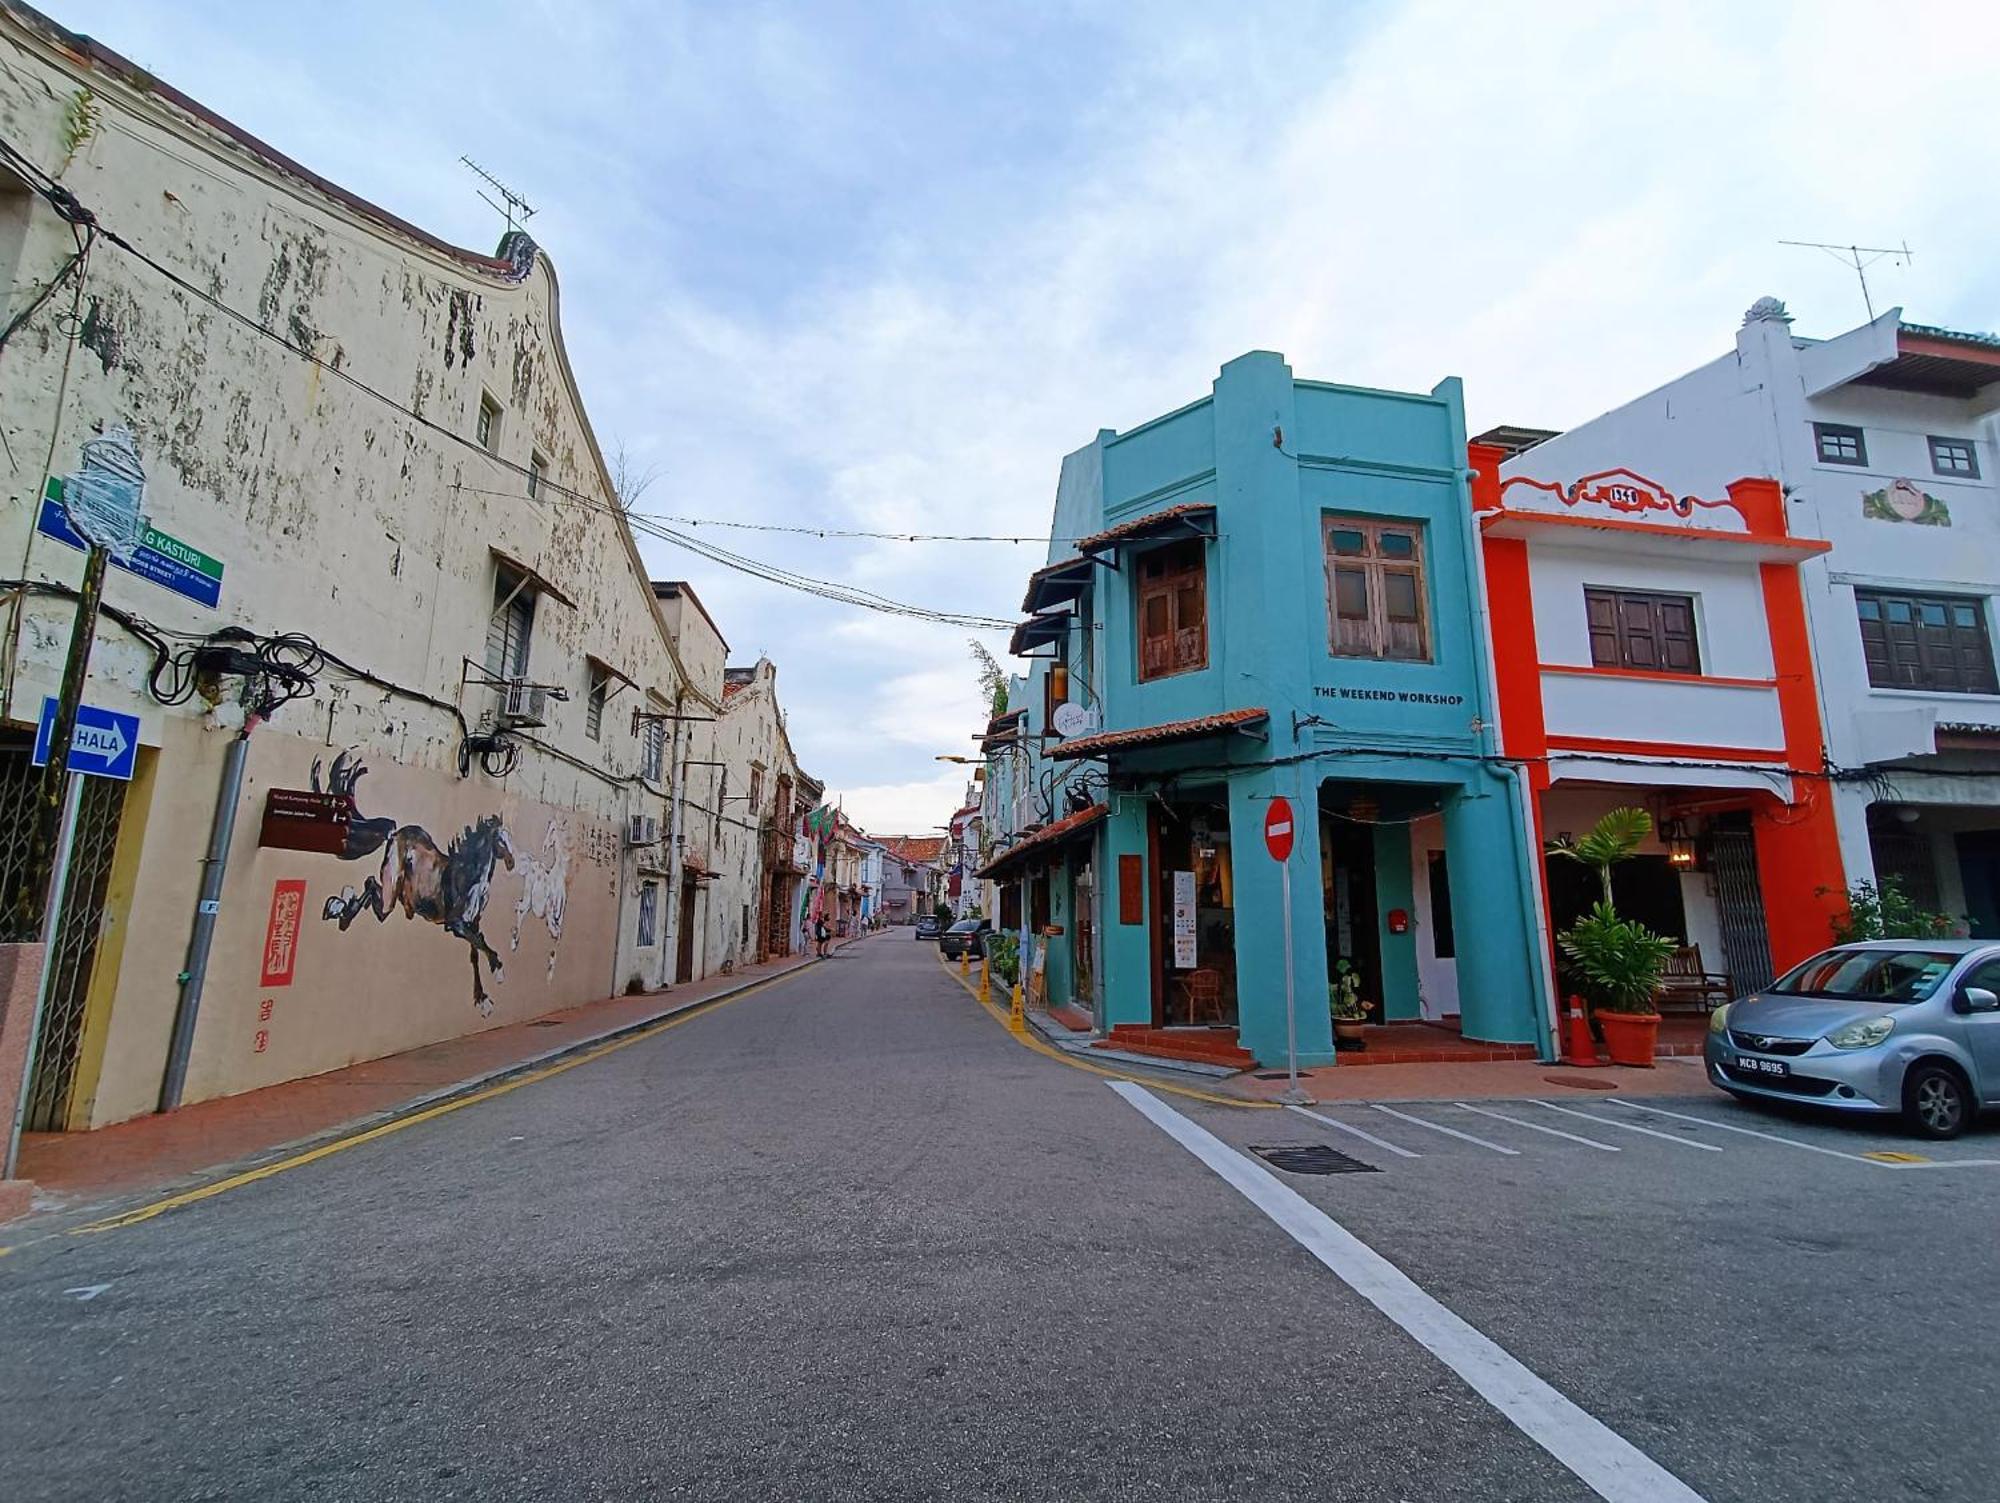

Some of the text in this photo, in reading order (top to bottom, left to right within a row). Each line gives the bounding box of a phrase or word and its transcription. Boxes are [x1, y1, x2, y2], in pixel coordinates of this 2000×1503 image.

[157, 536, 200, 568] KASTURI
[1313, 686, 1464, 705] THE WEEKEND WORKSHOP
[77, 730, 118, 752] HALA
[1739, 1056, 1758, 1070] MCB
